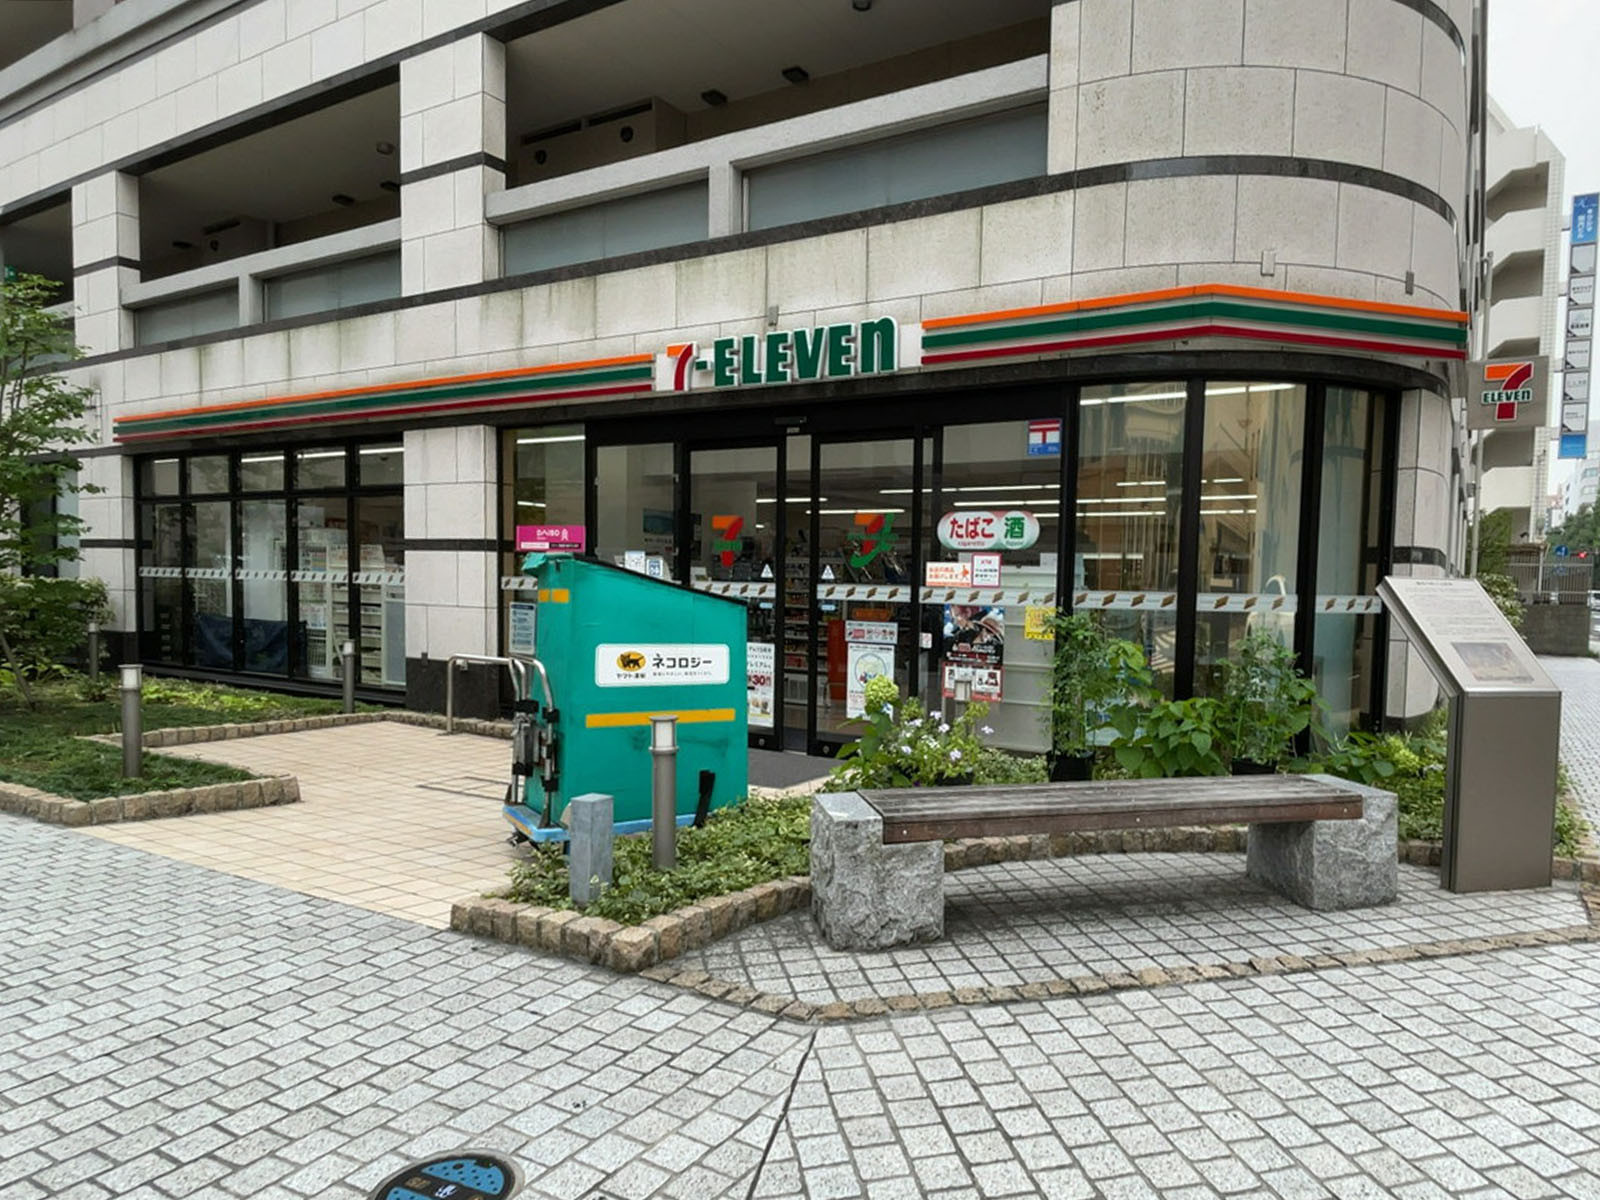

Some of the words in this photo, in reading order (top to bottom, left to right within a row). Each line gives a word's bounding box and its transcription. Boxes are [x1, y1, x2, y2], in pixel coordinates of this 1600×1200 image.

[949, 516, 995, 539] たばこ
[1004, 516, 1025, 539] 酒
[652, 653, 713, 669] ネコロジー
